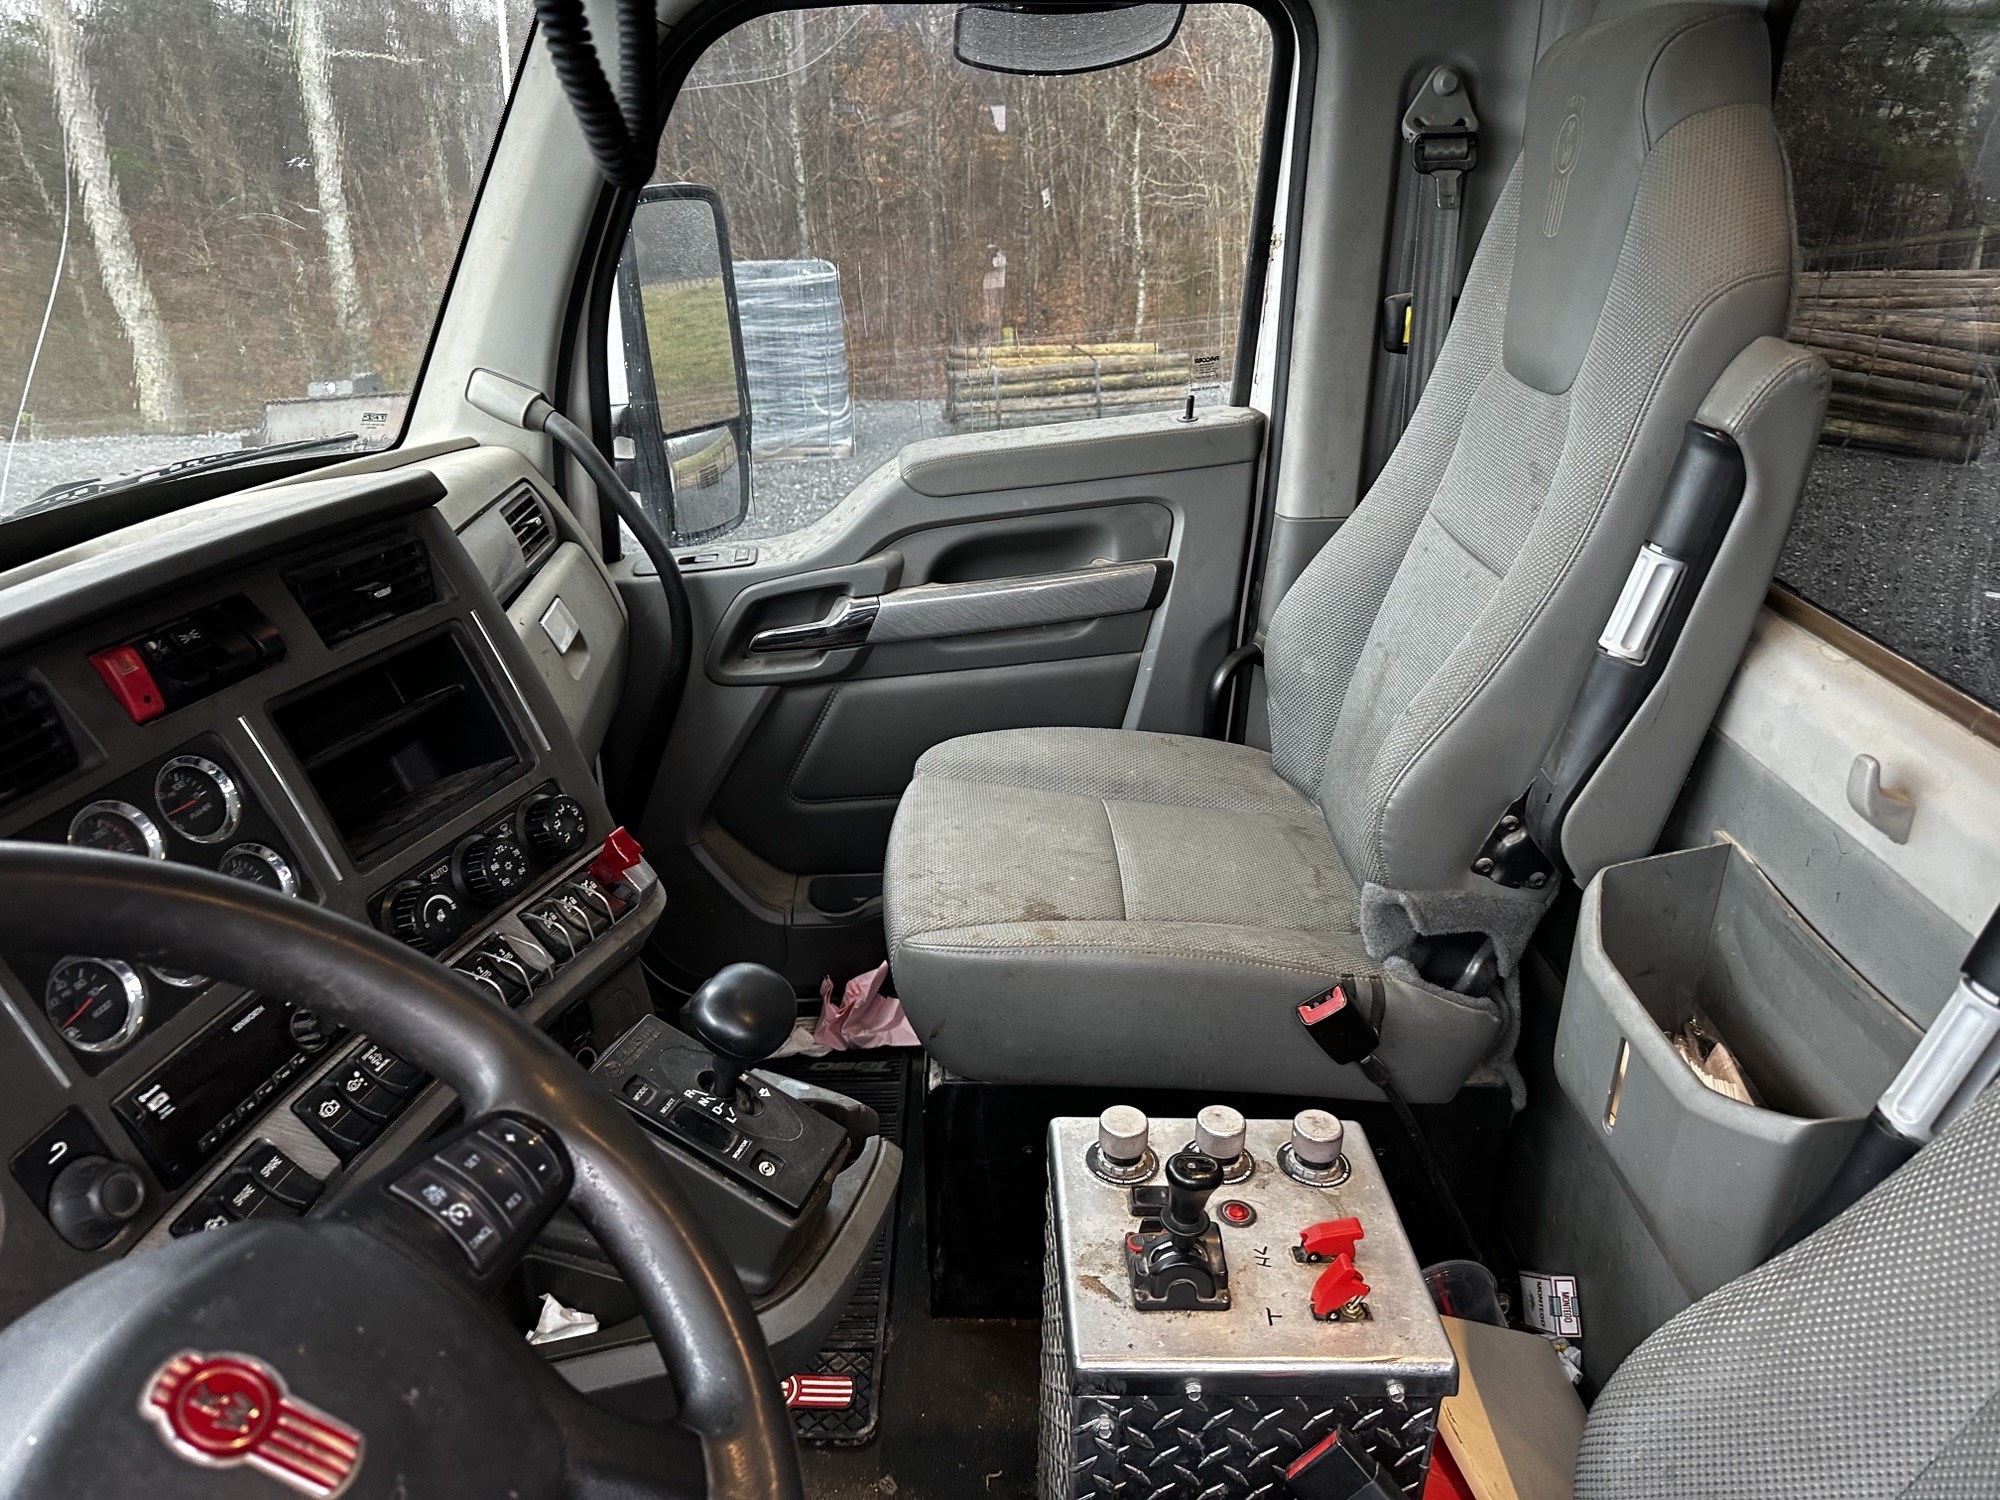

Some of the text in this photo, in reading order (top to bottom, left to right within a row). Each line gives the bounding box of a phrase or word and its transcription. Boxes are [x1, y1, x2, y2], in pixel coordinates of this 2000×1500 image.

[430, 864, 448, 881] AUTO
[1536, 1281, 1546, 1327] MONTEGO
[1561, 1291, 1573, 1323] MONTEGO
